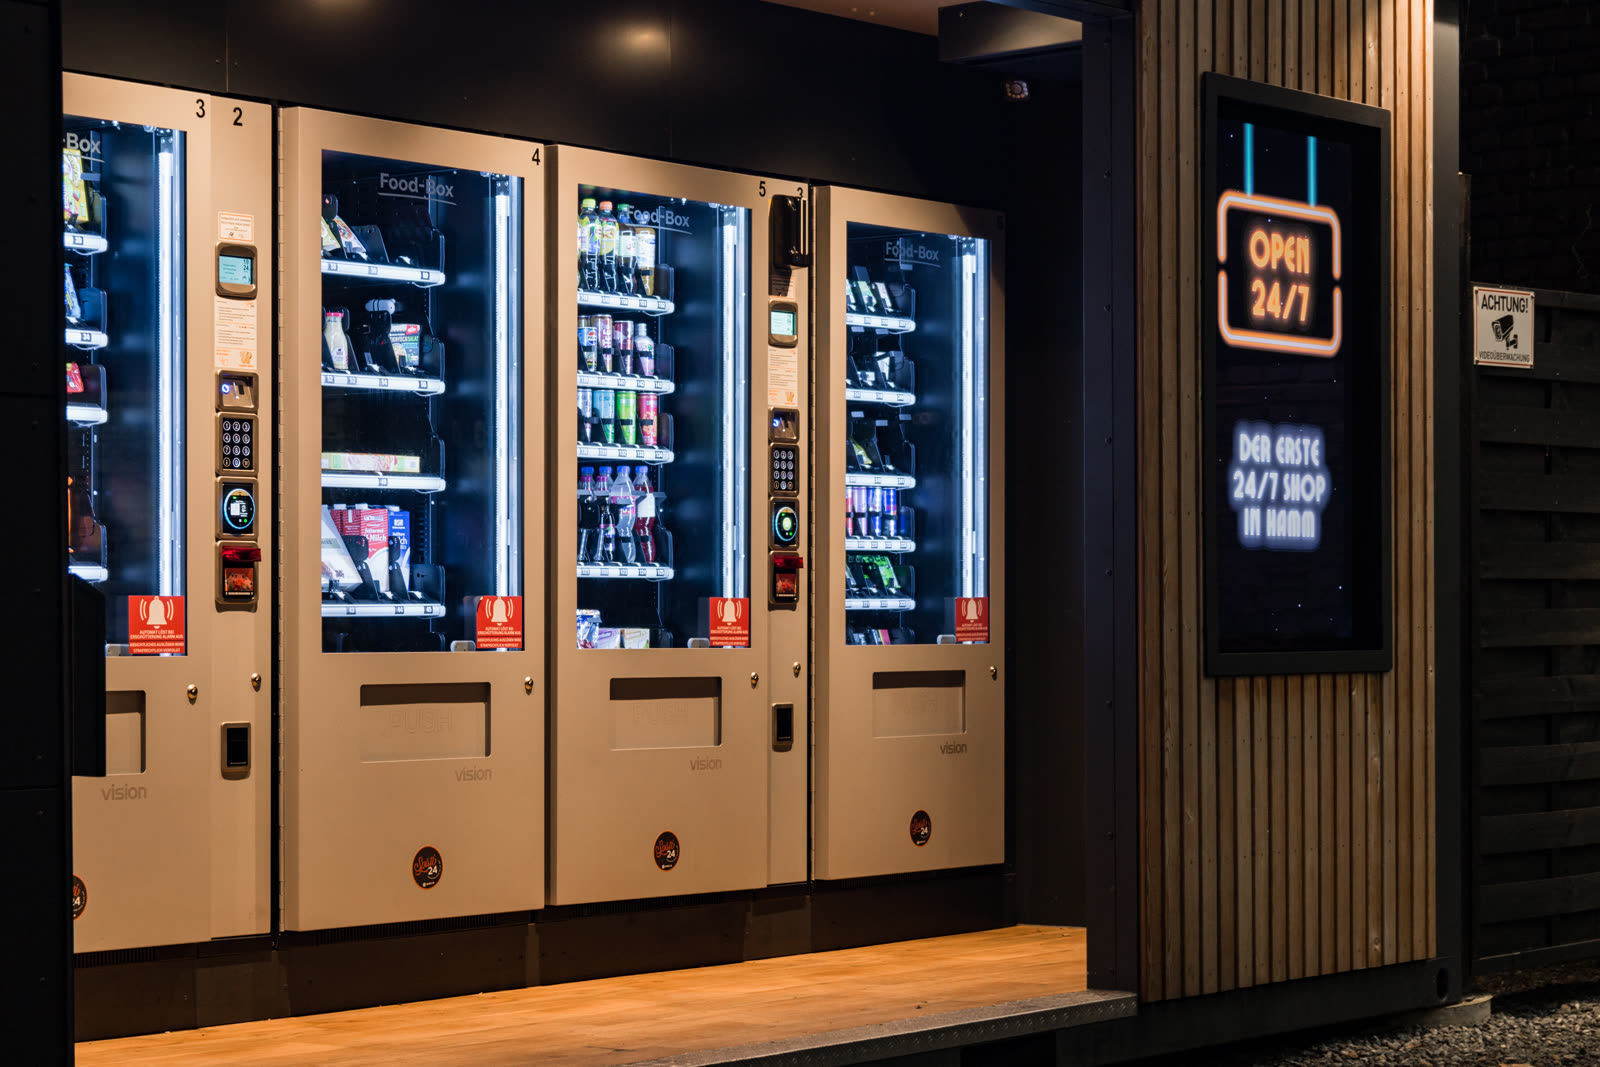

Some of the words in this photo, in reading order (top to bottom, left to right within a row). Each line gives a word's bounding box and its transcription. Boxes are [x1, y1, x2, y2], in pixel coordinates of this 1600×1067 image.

[196, 98, 205, 118] 3
[233, 106, 243, 126] 2
[531, 148, 541, 165] 4
[380, 172, 454, 198] Food-Box
[759, 180, 766, 197] 5
[627, 205, 690, 228] Food-Box
[886, 241, 939, 261] Food-Box
[1249, 229, 1311, 275] OPEN
[1251, 279, 1311, 322] 24/7
[1481, 294, 1529, 313] ACHTUNG!
[1479, 350, 1530, 362] VIDEOÜBERWACHUNG
[1239, 433, 1271, 463] DER
[1275, 436, 1320, 467] ERSTE
[1233, 470, 1279, 501] 24/7
[1283, 473, 1326, 503] SHOP
[1243, 507, 1261, 536] IN
[1266, 508, 1315, 538] HAMM
[940, 741, 967, 755] vision
[689, 756, 722, 771] vision
[454, 765, 492, 783] vision
[101, 783, 147, 801] vision
[667, 849, 675, 858] 24
[428, 865, 438, 875] 24
